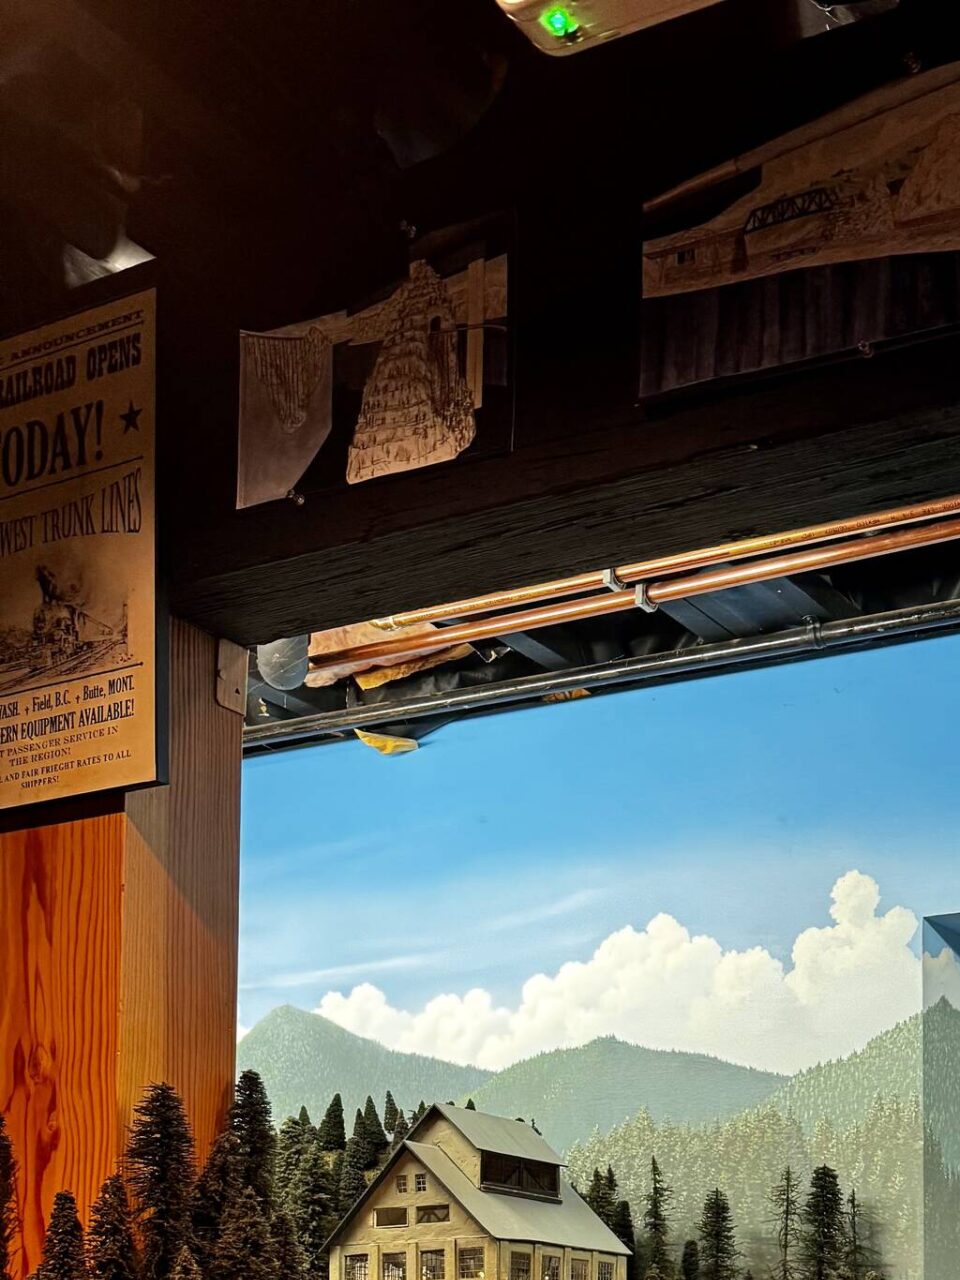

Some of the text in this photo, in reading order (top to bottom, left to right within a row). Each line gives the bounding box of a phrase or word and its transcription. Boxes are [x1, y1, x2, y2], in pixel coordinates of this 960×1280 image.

[10, 309, 144, 361] ANNOUNCEMENT
[86, 332, 142, 382] OPENS
[0, 400, 104, 487] ODAY!
[42, 493, 96, 544] TRUNK
[101, 467, 142, 534] LINES
[32, 693, 53, 712] Field,
[55, 690, 71, 708] B.C.
[83, 685, 106, 700] Butte,
[108, 675, 135, 695] MONT.
[0, 699, 135, 744] ERN EQUIPMENT AVAILABLE!
[7, 738, 61, 757] PASSENGER
[63, 728, 105, 745] SERVICE
[107, 726, 119, 735] IN
[4, 773, 20, 783] AND
[21, 768, 38, 779] FAIR
[41, 760, 74, 774] FRIEGHT
[76, 755, 101, 768] RATES
[103, 753, 114, 762] TO
[115, 749, 131, 760] ALL
[9, 747, 71, 767] THE REGION!
[21, 775, 59, 789] SHIPPERS!
